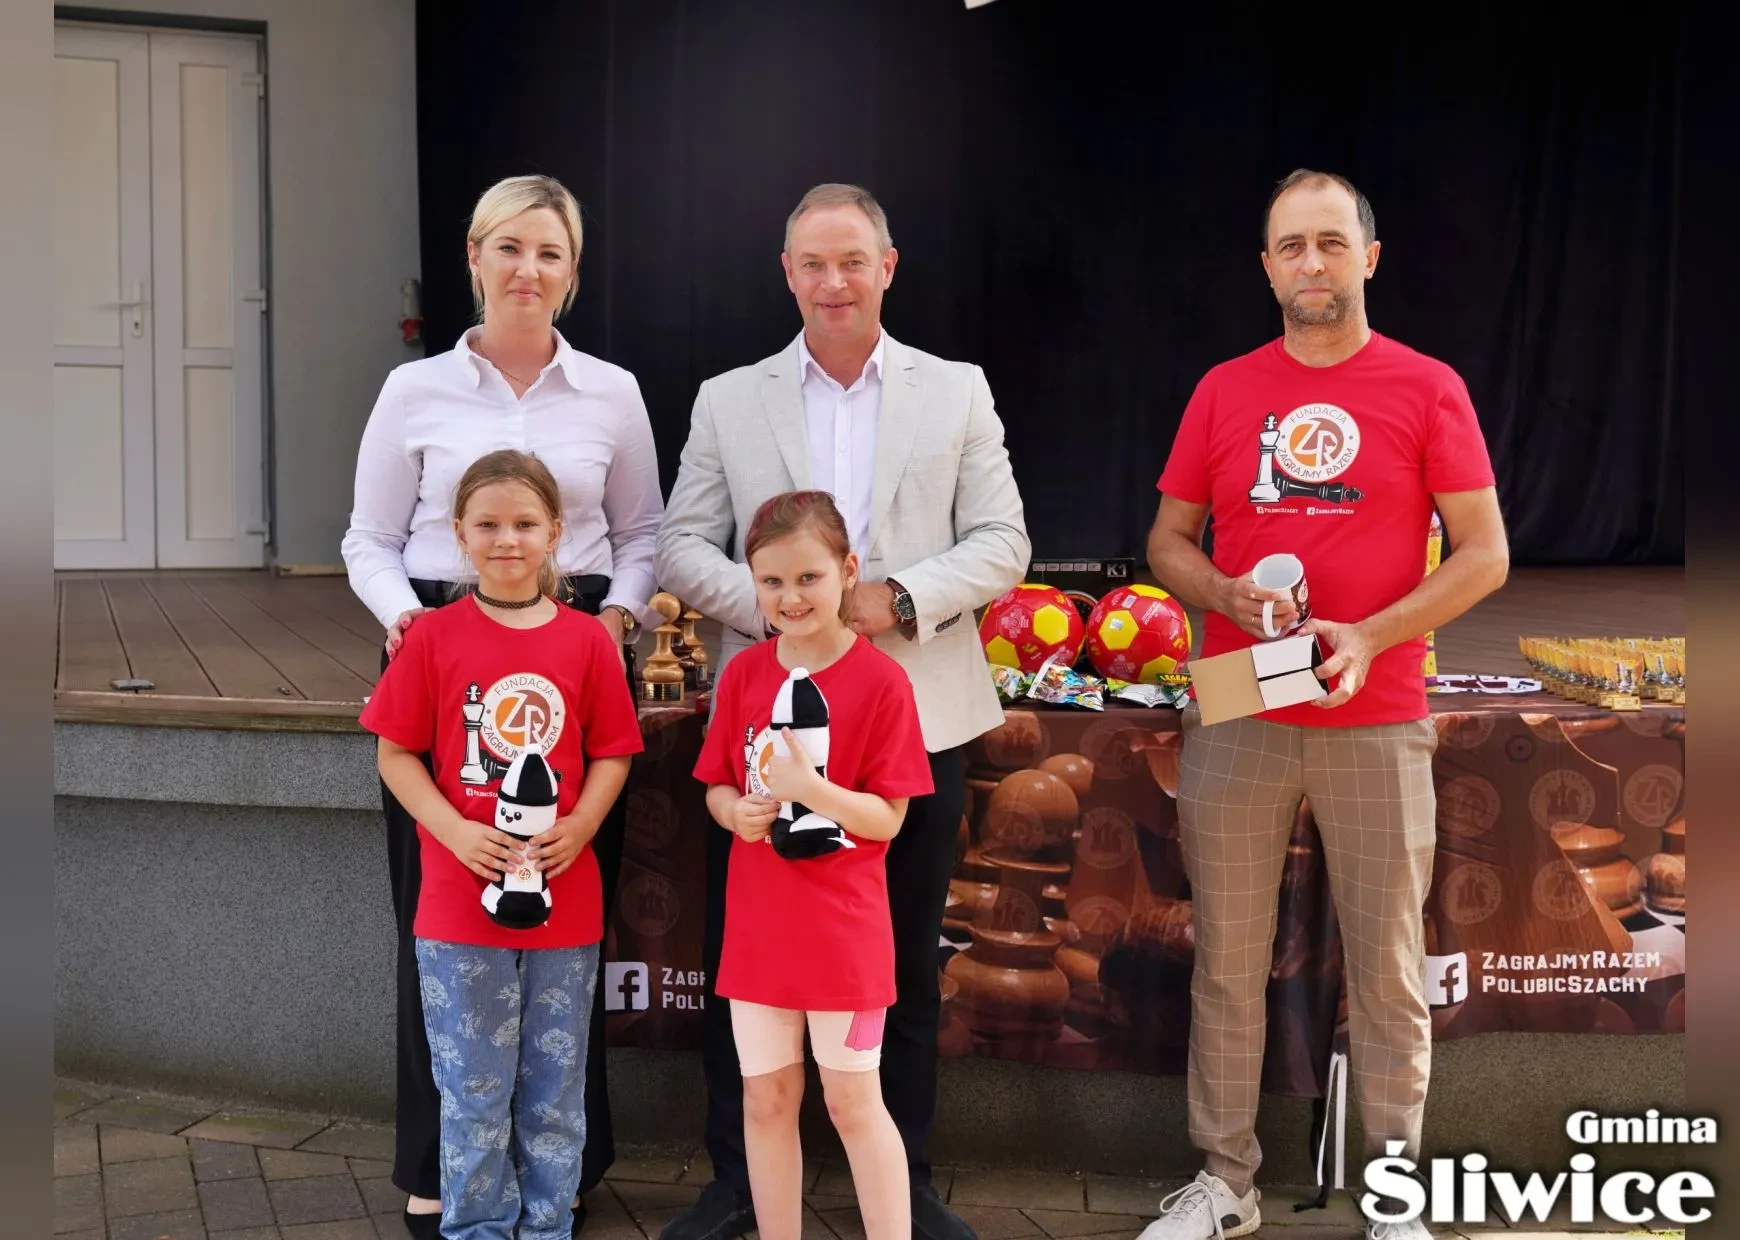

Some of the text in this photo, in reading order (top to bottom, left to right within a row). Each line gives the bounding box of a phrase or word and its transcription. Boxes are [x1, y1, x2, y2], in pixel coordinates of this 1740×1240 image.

[1289, 406, 1348, 425] FUNDACJA
[1278, 447, 1356, 479] ZAGRAJMY RAZEM
[1106, 563, 1127, 578] K1
[494, 676, 555, 698] FUNDACJA
[483, 723, 560, 760] ZAGRAJM AZEM
[662, 991, 705, 1010] POL
